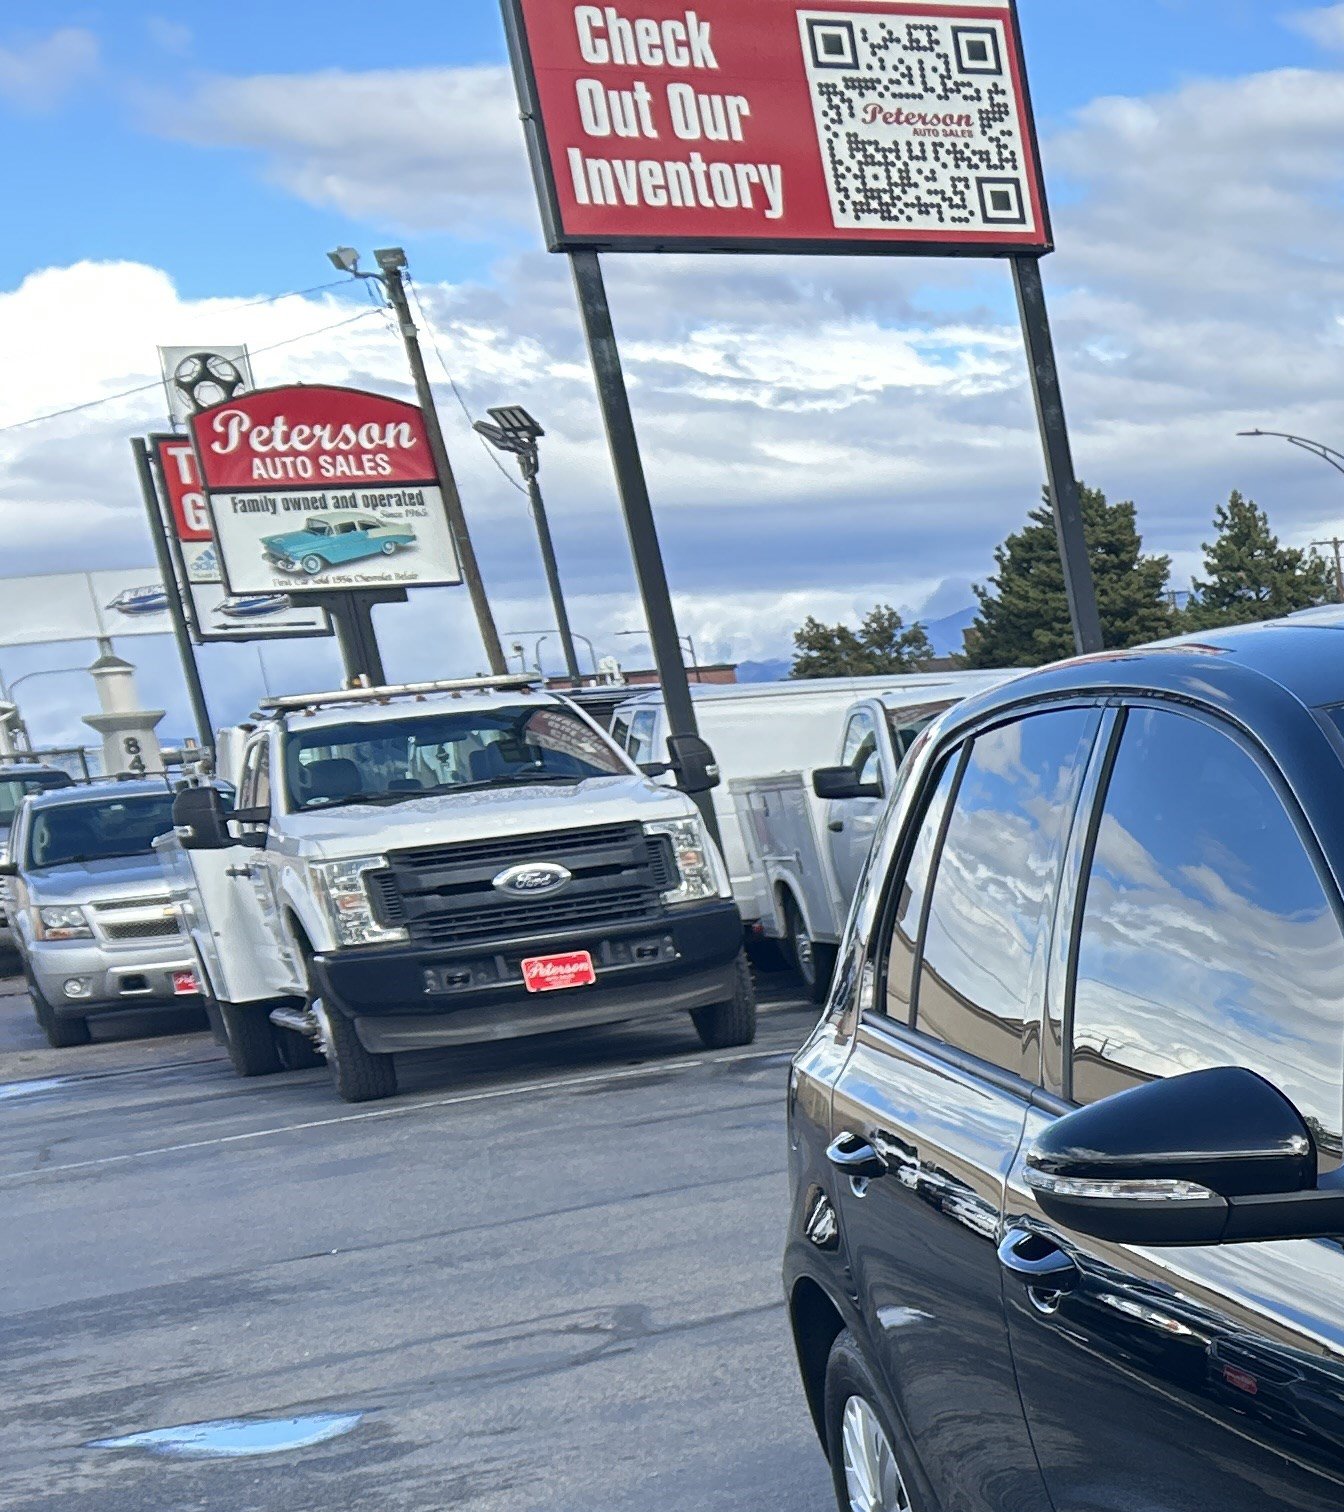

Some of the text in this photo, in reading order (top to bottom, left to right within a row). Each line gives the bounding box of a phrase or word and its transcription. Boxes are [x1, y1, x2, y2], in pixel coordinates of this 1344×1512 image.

[574, 6, 719, 70] Check
[575, 79, 751, 142] Out Our
[861, 102, 975, 126] Peterson
[912, 127, 974, 139] AUTO SALES
[568, 148, 783, 220] Inventory
[210, 409, 417, 454] Peterson
[252, 453, 392, 480] AUTO SALES
[230, 495, 277, 515] Family
[281, 492, 327, 512] owned
[331, 491, 358, 510] and
[361, 489, 425, 511] operated
[515, 871, 551, 889] Ford
